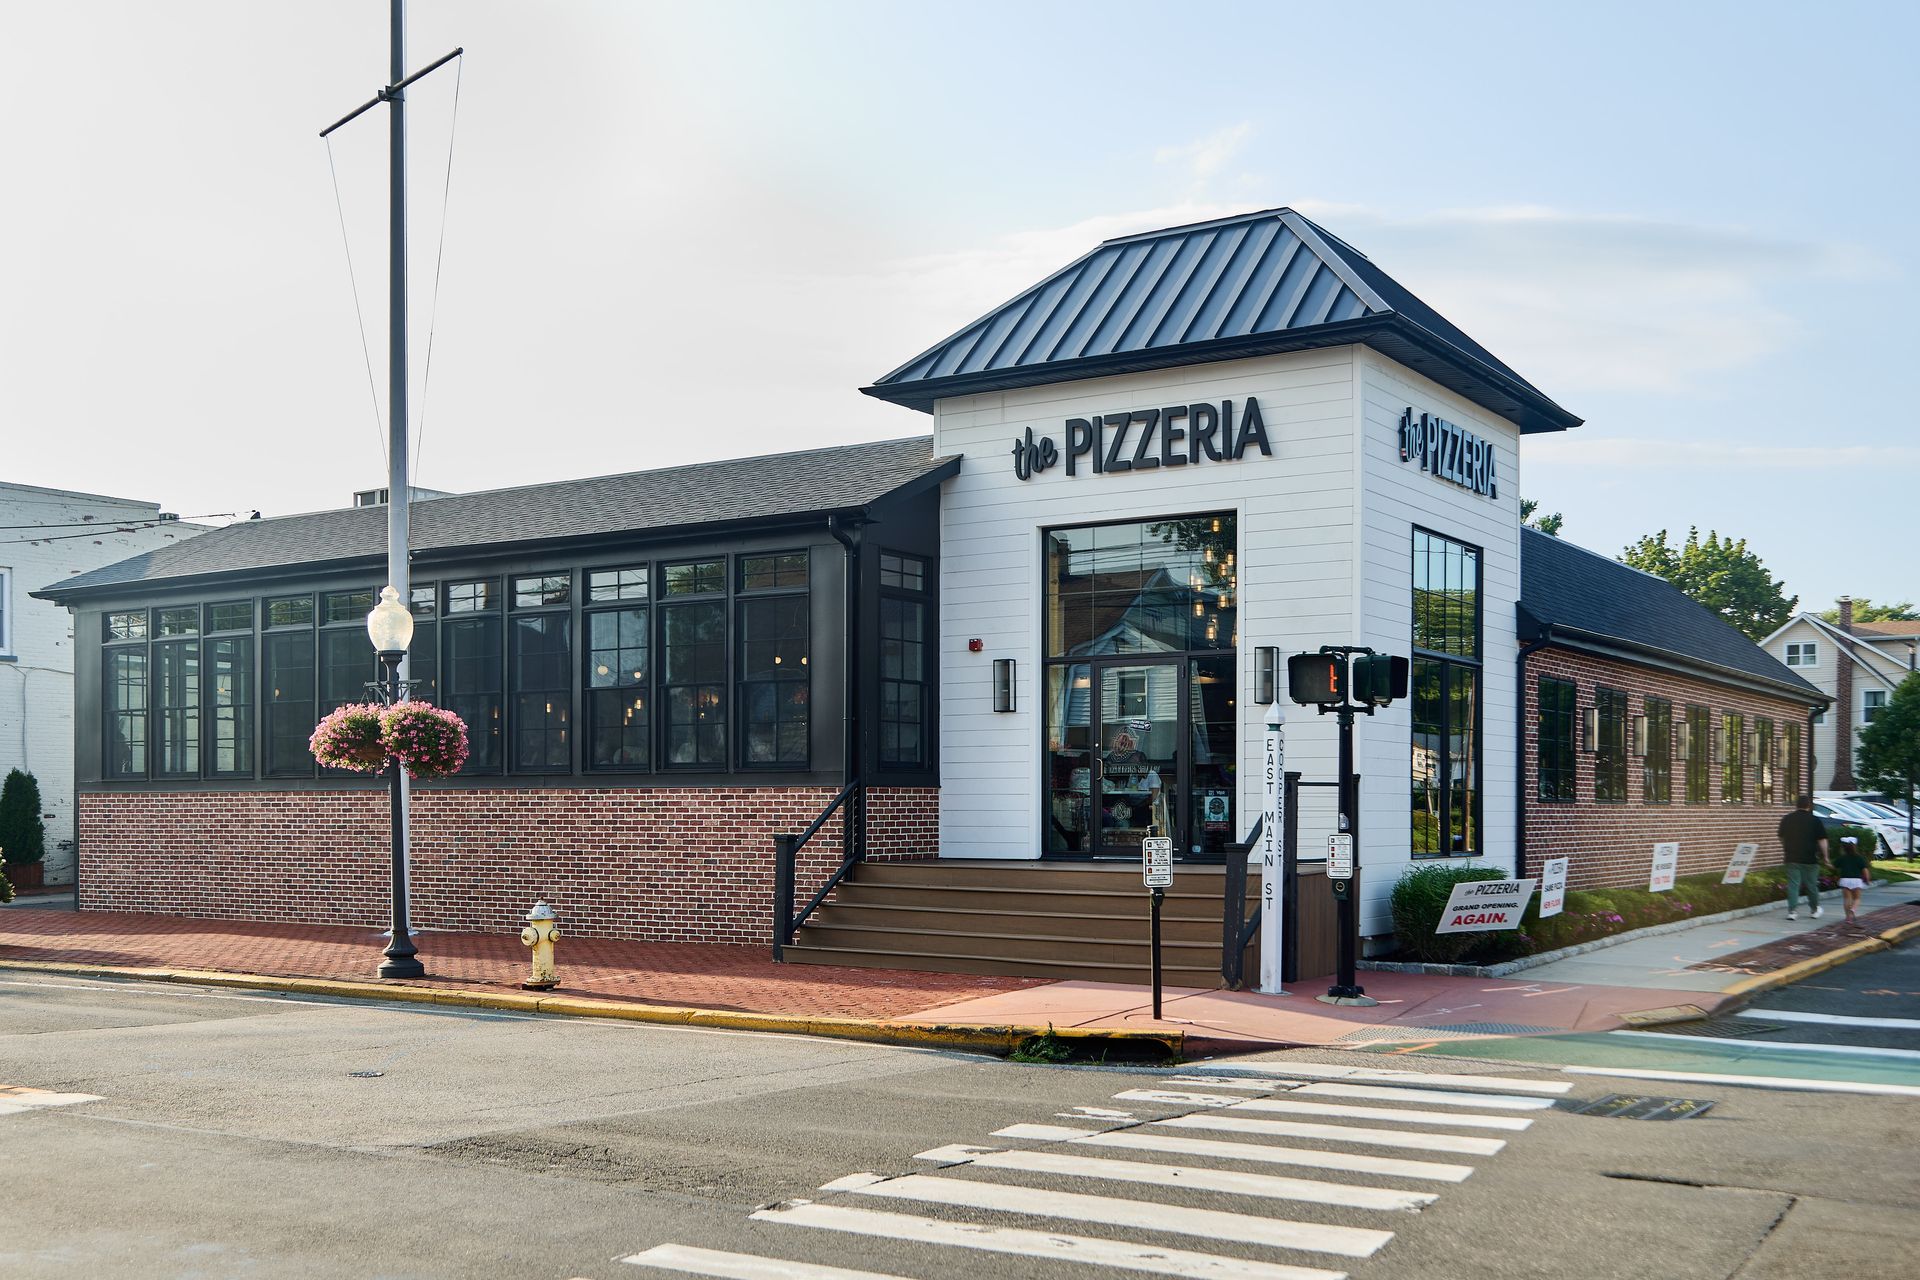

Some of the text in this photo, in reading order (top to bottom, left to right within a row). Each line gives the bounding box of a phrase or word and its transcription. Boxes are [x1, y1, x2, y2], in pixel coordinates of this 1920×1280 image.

[1011, 397, 1272, 481] the PIZZERIA
[1400, 407, 1499, 499] the PIZZERIA
[1264, 739, 1275, 910] EAST MAIN ST
[1277, 840, 1282, 867] ST
[1475, 883, 1520, 896] PIZZERIA
[1450, 913, 1508, 926] AGAIN.
[1452, 902, 1519, 912] GRAND OPENING.
